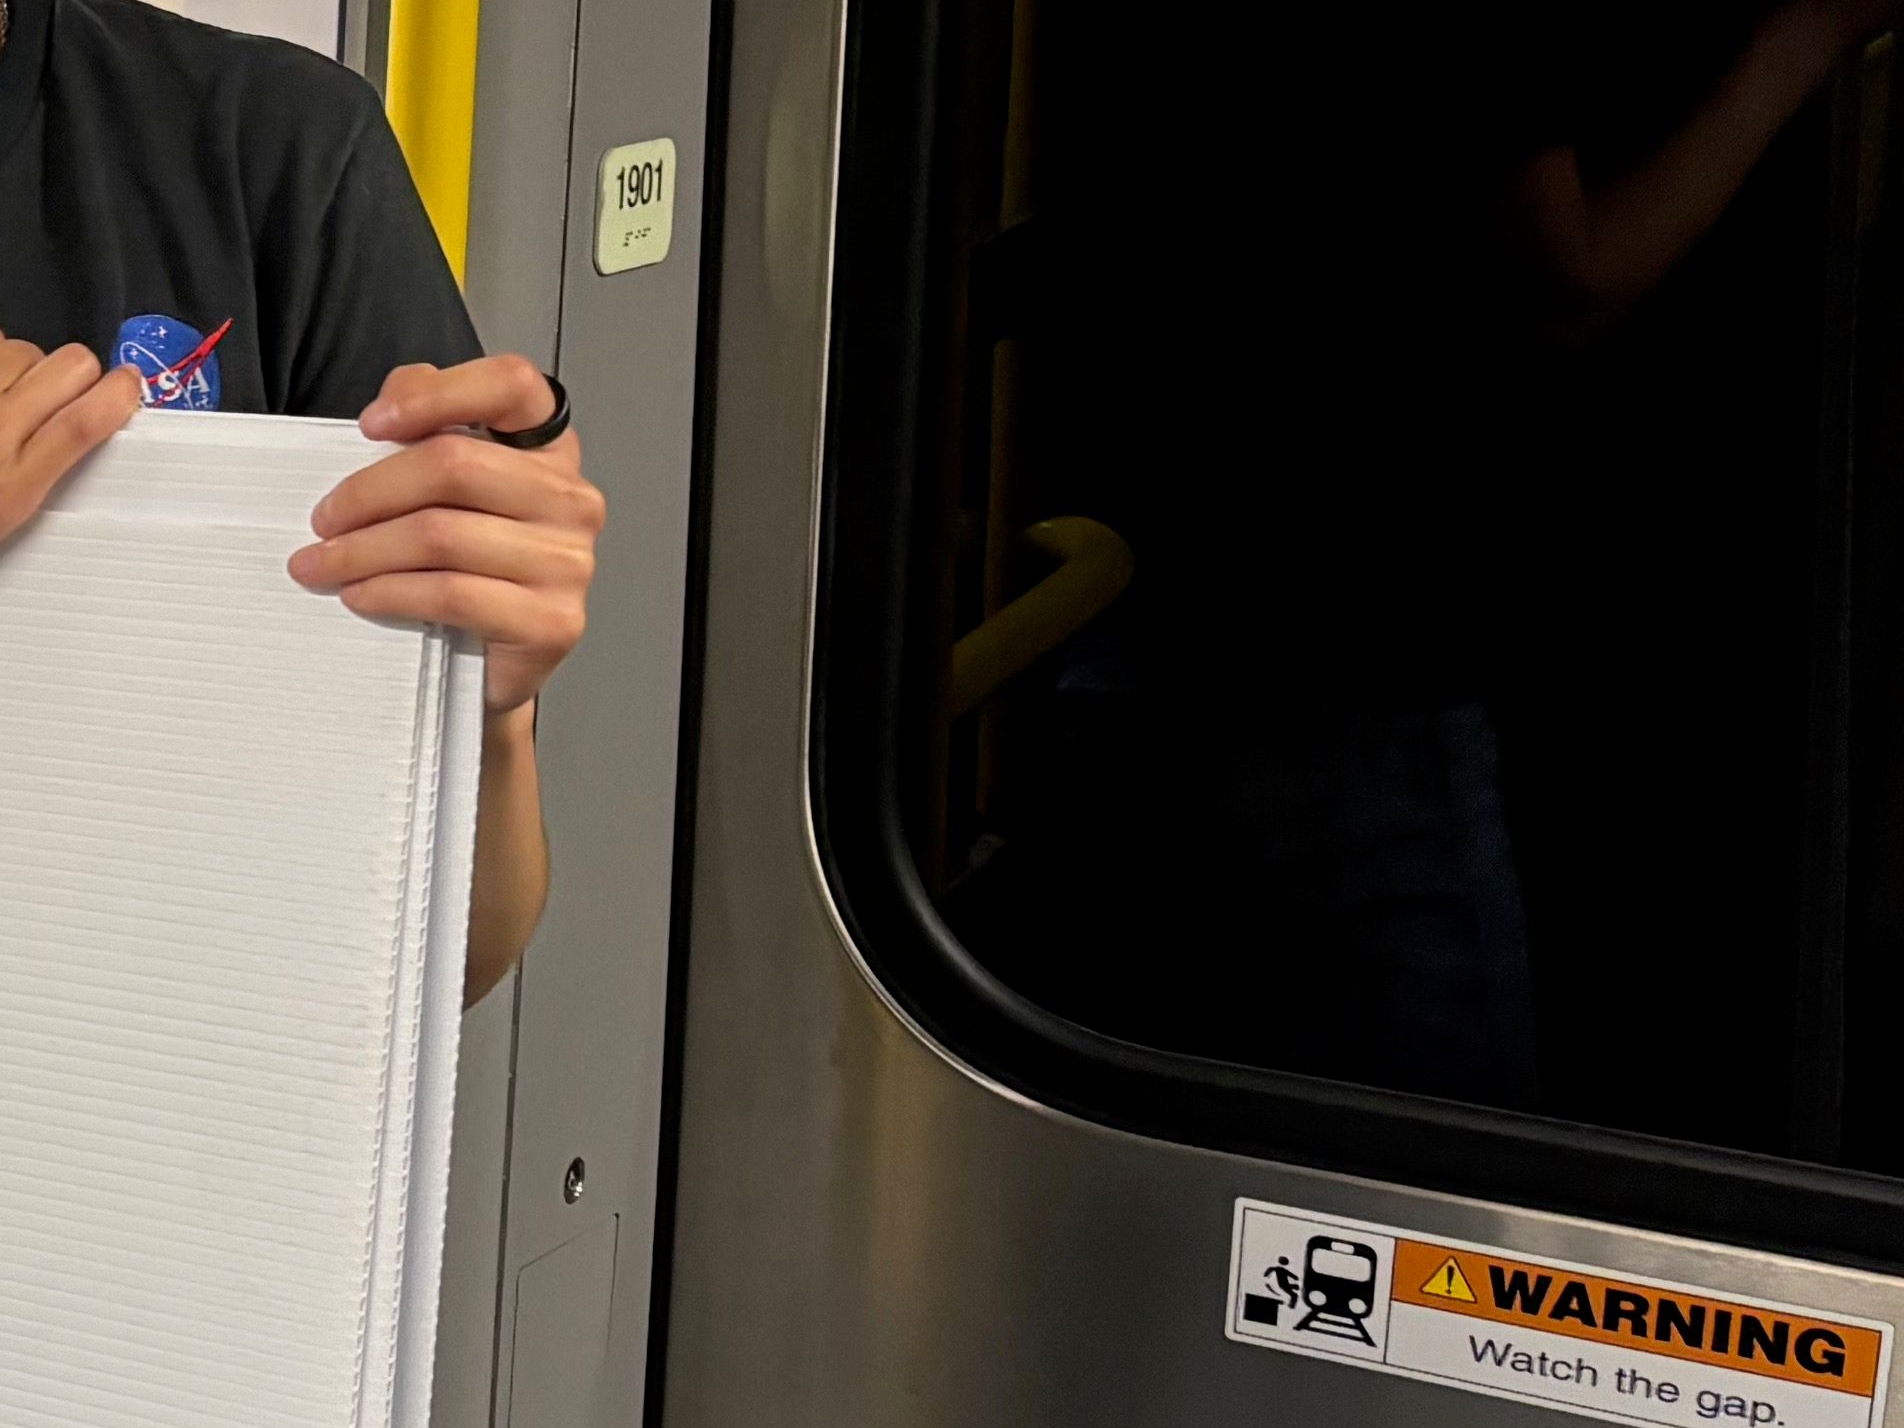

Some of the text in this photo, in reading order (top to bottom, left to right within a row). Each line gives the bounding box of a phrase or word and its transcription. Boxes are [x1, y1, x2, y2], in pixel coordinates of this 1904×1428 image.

[617, 157, 663, 210] 1901
[1487, 1264, 1848, 1377] WARNING
[1468, 1334, 1787, 1428] Watch the gap.
